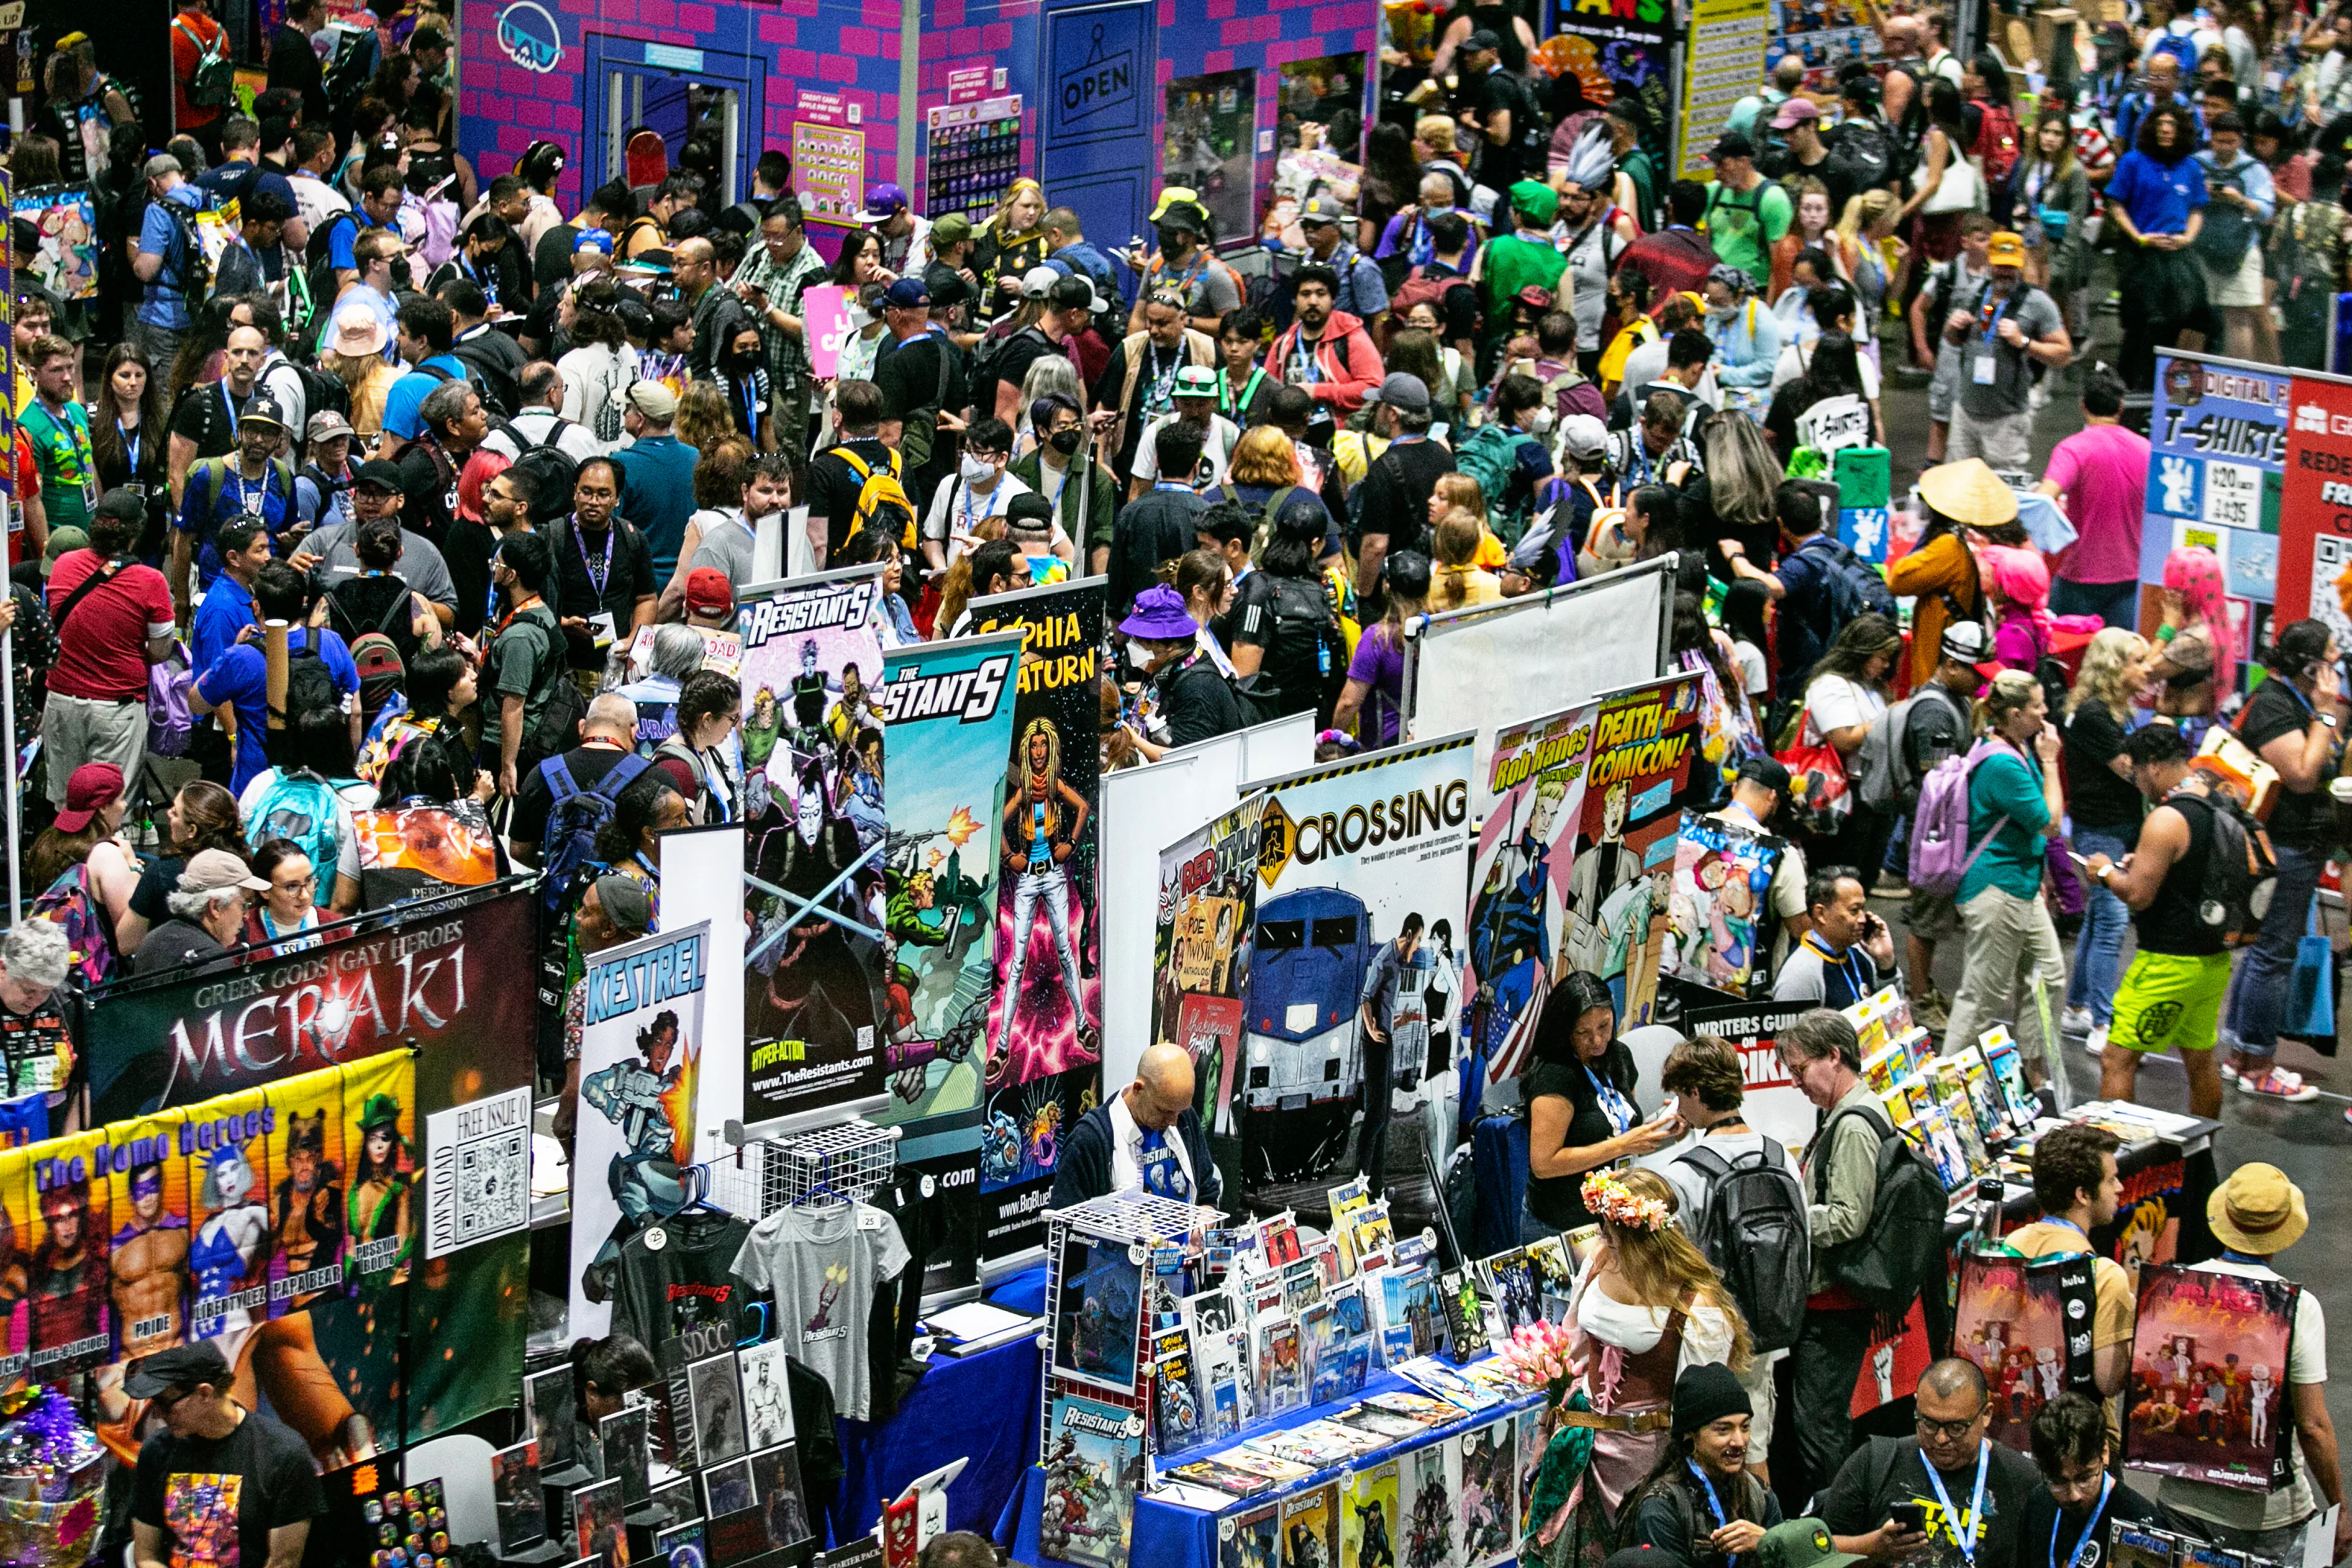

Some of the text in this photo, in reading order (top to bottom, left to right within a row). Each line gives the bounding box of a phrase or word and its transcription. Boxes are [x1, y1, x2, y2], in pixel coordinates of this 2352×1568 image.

[1064, 66, 1129, 109] OPEN
[2203, 372, 2273, 406] DIGITAL
[805, 591, 817, 600] THE
[747, 583, 872, 646] RESISTANTS
[709, 641, 741, 658] DAD!
[898, 665, 919, 681] THE
[1016, 647, 1094, 694] ATURN
[884, 656, 1011, 720] STANTS
[1595, 704, 1680, 750] DEATH AT
[1493, 725, 1591, 795] Rob Hanes
[1588, 733, 1690, 788] COMICON!
[1536, 762, 1583, 789] ADVENTURES
[1293, 779, 1468, 865] CROSSING
[1182, 820, 1261, 898] RED STYLO
[1188, 918, 1205, 934] POE
[194, 974, 262, 1009] GREEK
[272, 959, 329, 990] GODS
[339, 941, 386, 971] GAY
[389, 921, 463, 959] HEROES
[587, 934, 706, 1026] KESTREL
[158, 945, 466, 1110] MERAKI
[1694, 1015, 1760, 1038] WRITERS
[752, 1040, 790, 1072] HYPER-ACTION
[1742, 1037, 1757, 1048] ON
[752, 1056, 873, 1091] www.TheResistants.com
[457, 1108, 484, 1140] FREE
[487, 1097, 516, 1131] ISSUE
[34, 1108, 276, 1191] The Homo Heroes
[434, 1146, 454, 1250] DOWNLOAD
[648, 1231, 663, 1243] $25
[1068, 1233, 1100, 1248] RESISTANTS
[361, 1252, 396, 1275] BOOTS
[1132, 1248, 1144, 1260] $10
[306, 1265, 342, 1294] BEAR
[2061, 1274, 2085, 1287] hulu
[194, 1286, 267, 1323] LIBERTY LEZ
[133, 1315, 171, 1339] PRIDE
[803, 1326, 848, 1344] RESISTANTS
[683, 1323, 731, 1361] SDCC
[1163, 1359, 1183, 1373] SOPHIA
[1167, 1369, 1187, 1381] SATURN
[1062, 1406, 1127, 1440] RESISTANTS
[1131, 1418, 1142, 1430] $5
[1463, 1438, 1474, 1450] $10
[1341, 1473, 1352, 1485] $10
[2207, 1468, 2269, 1486] animayhem
[1284, 1492, 1324, 1520] RESISTANTS
[1221, 1523, 1233, 1536] $10
[861, 1549, 881, 1561] PACK
